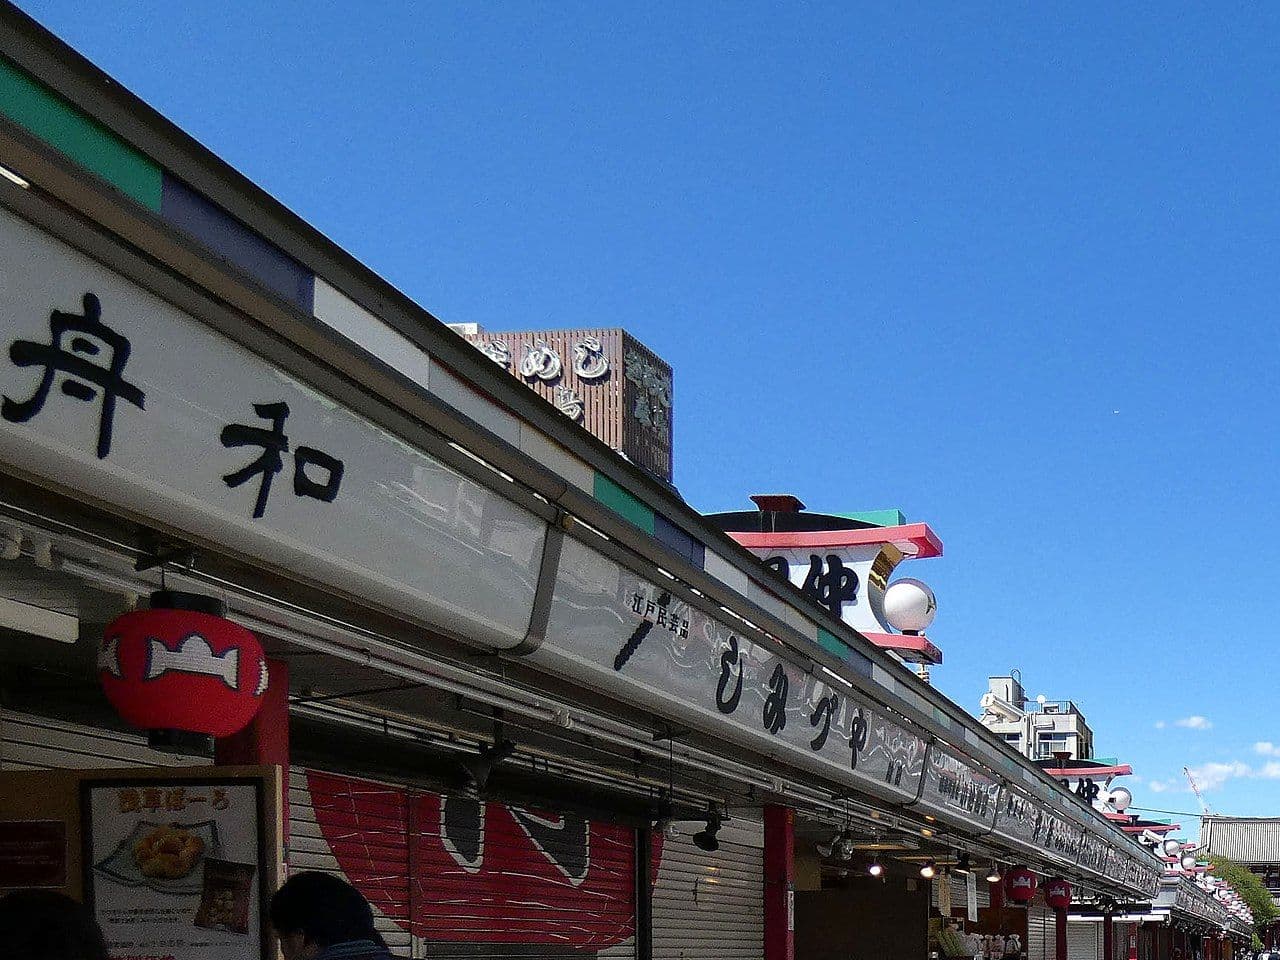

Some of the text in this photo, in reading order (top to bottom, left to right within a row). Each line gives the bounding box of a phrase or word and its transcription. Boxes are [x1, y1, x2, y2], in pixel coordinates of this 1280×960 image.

[2, 292, 345, 519] 舟和
[631, 592, 690, 640] 江戸民芸品
